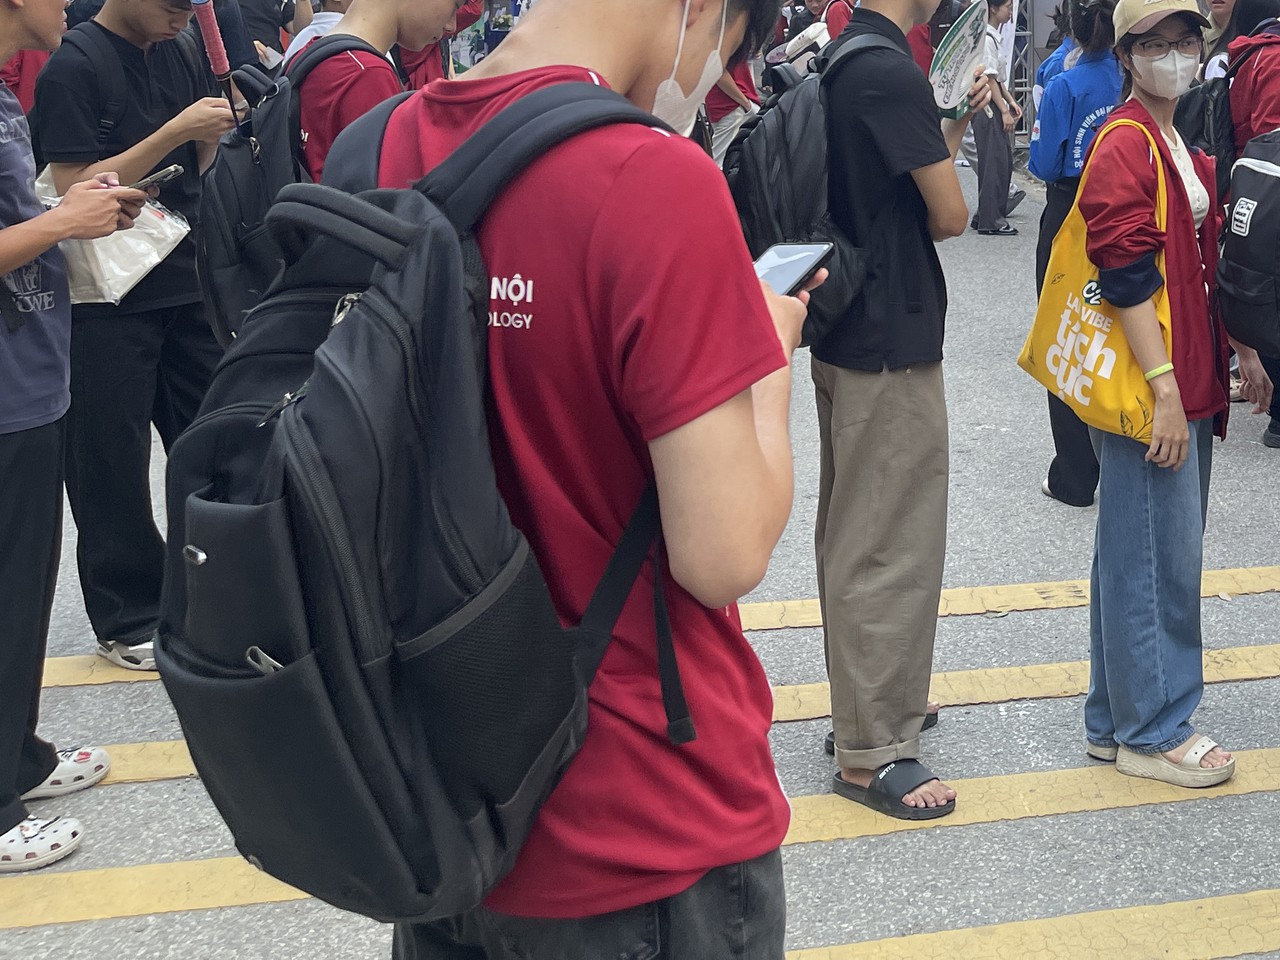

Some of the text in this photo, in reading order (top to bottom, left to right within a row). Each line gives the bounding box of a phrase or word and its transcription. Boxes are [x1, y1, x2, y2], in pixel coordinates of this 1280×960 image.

[490, 273, 534, 306] NỘI
[1080, 307, 1114, 333] VIBE
[1056, 309, 1117, 380] tích
[1045, 344, 1094, 407] cực
